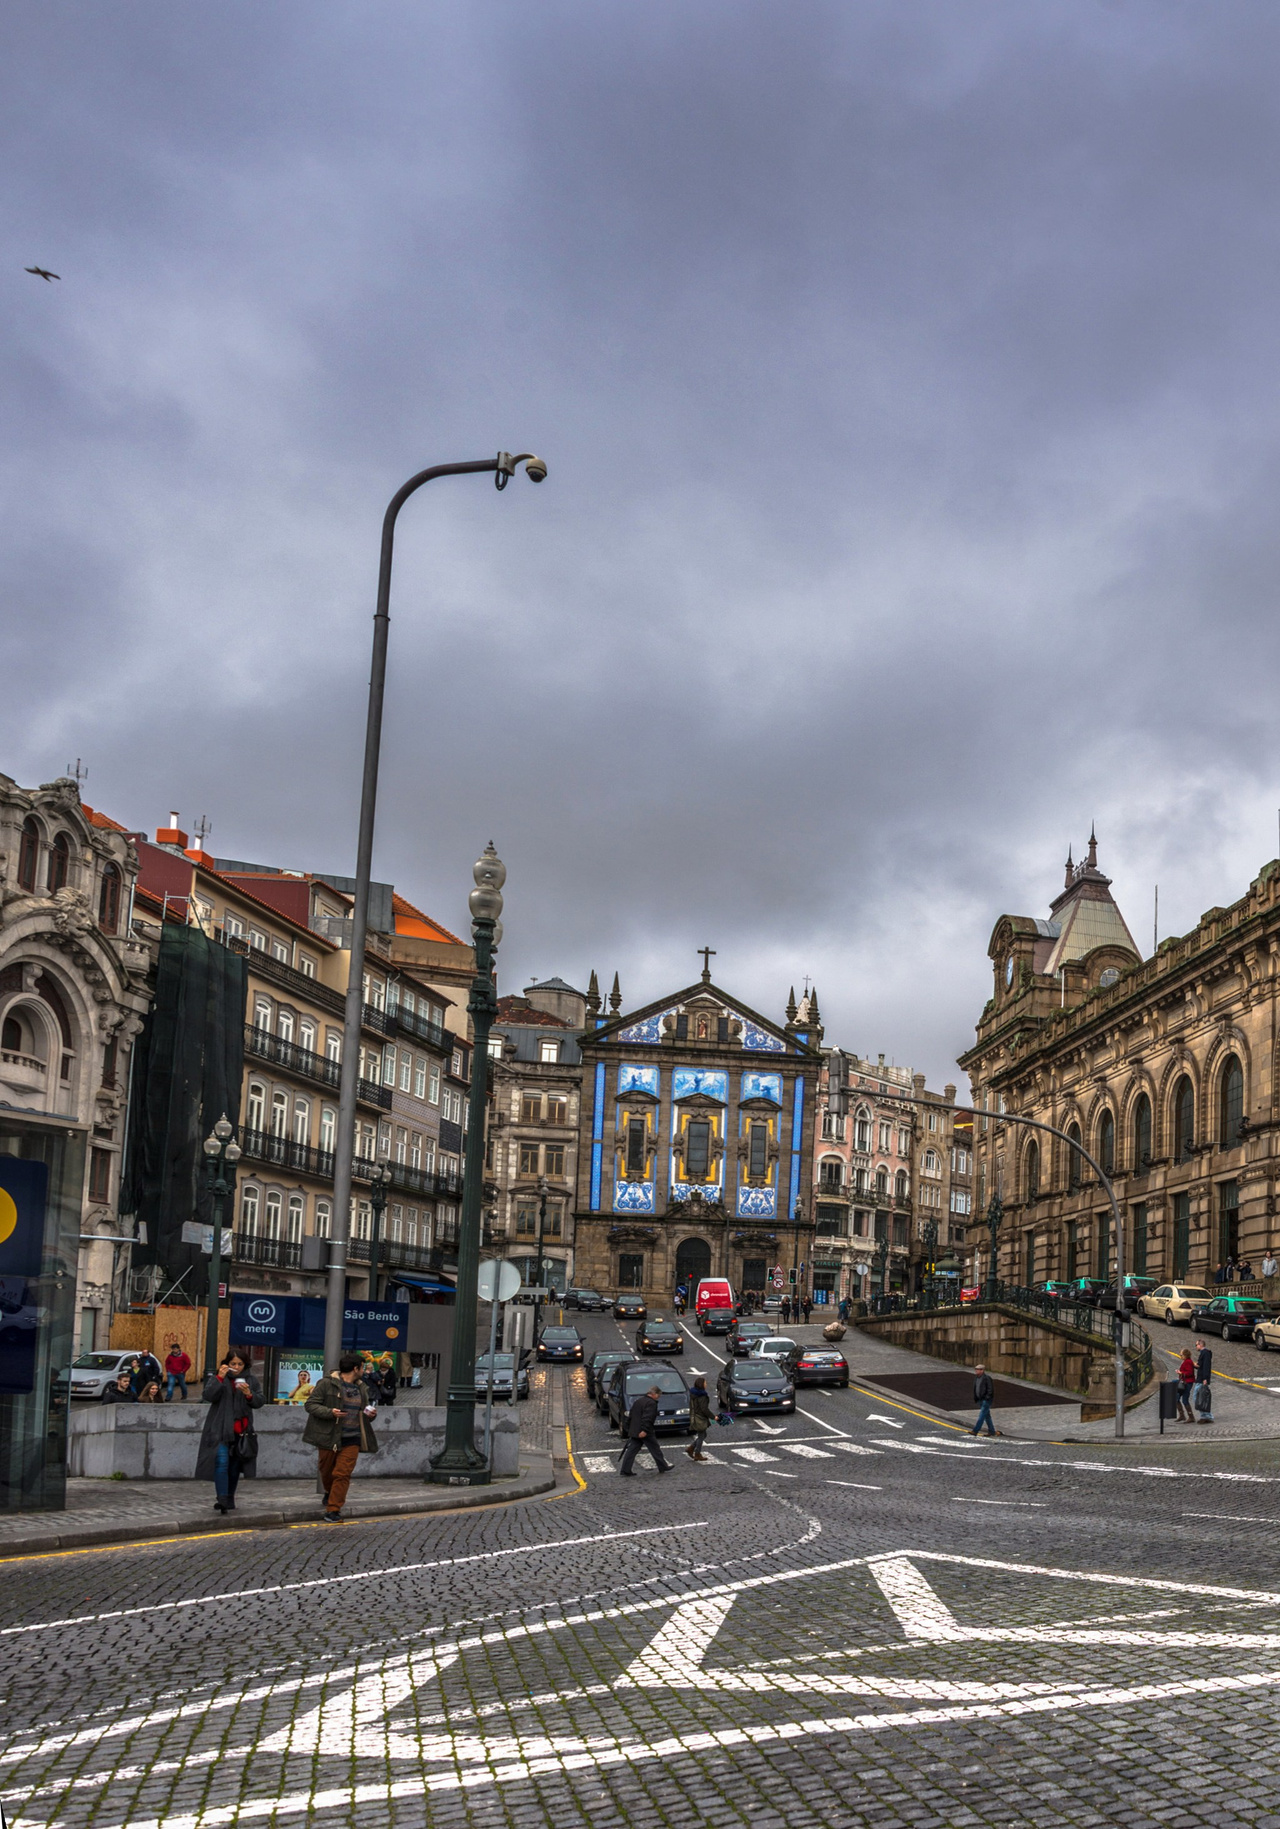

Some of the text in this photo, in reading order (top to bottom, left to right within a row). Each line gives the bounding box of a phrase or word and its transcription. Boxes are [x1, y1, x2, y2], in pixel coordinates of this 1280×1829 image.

[344, 1310, 400, 1321] São Bento
[245, 1325, 277, 1333] metro
[279, 1361, 325, 1371] BROOKLY
